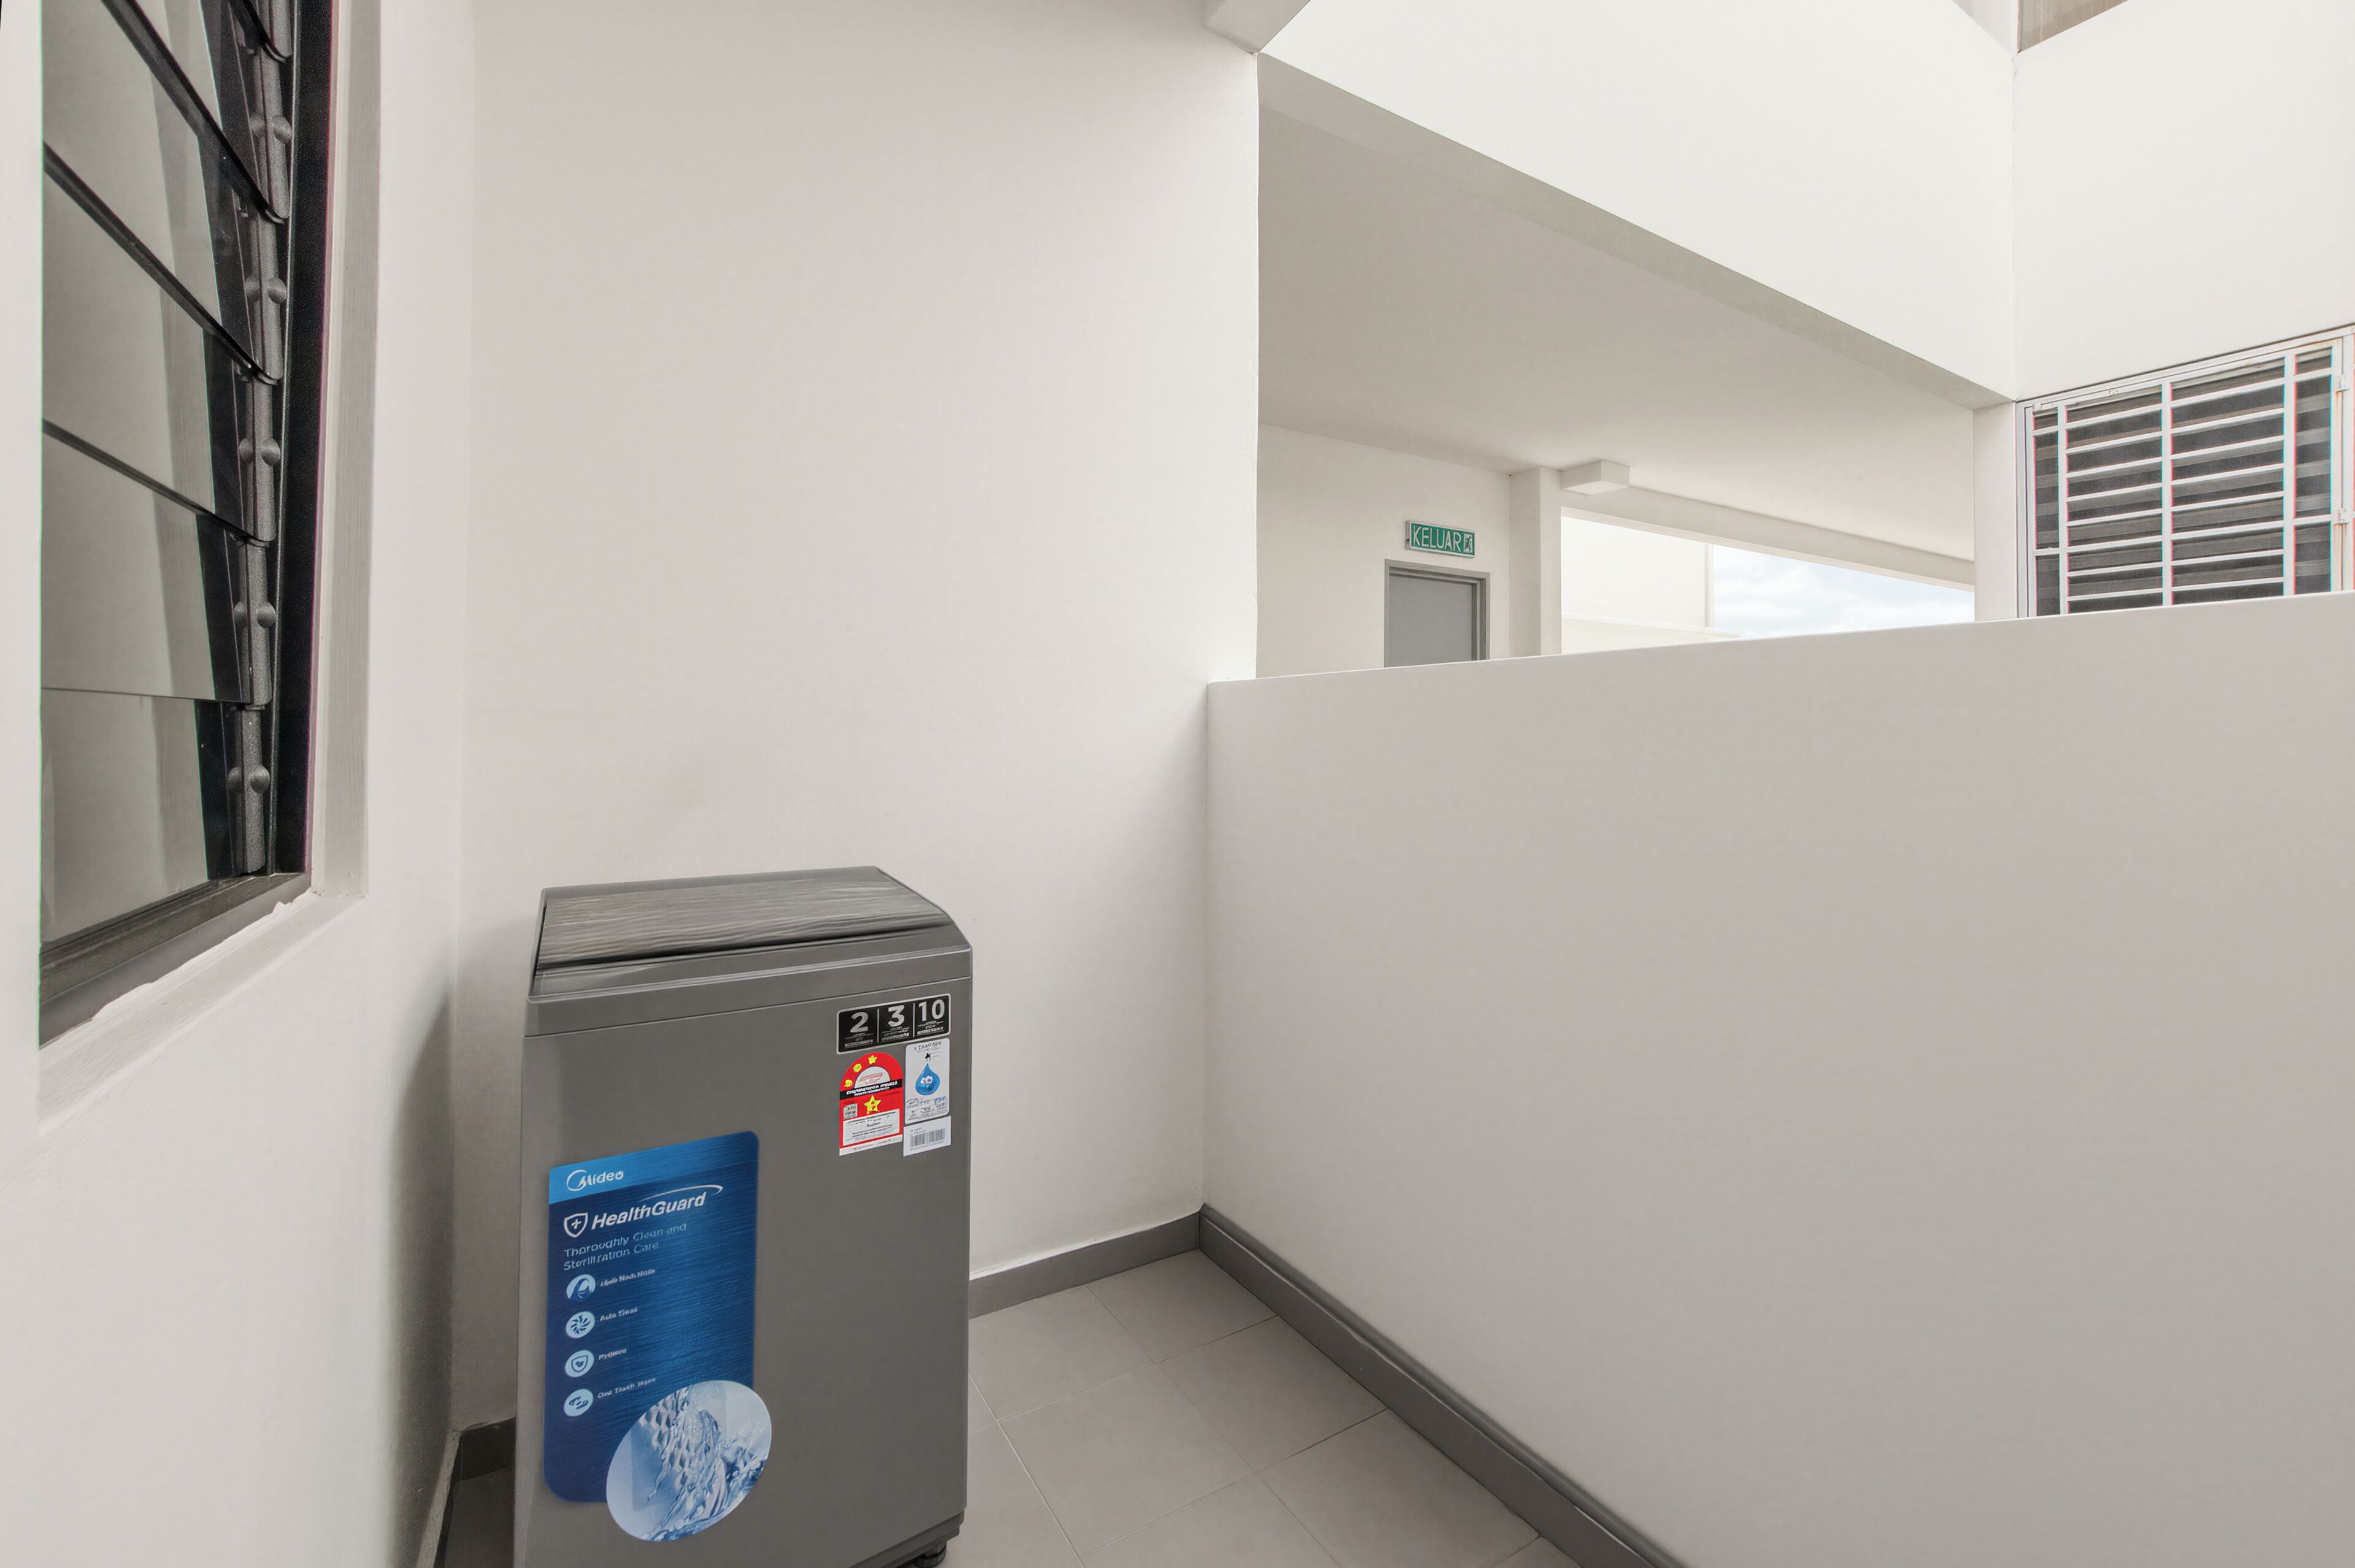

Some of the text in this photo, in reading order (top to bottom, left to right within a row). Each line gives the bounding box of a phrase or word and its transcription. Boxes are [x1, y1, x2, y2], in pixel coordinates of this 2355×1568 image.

[1412, 525, 1462, 552] KELUAR
[850, 1012, 868, 1033] 2
[887, 1004, 905, 1027] 3
[919, 998, 945, 1022] 10
[591, 1191, 707, 1231] HealthGuard
[666, 1222, 687, 1235] and
[634, 1242, 659, 1254] Care
